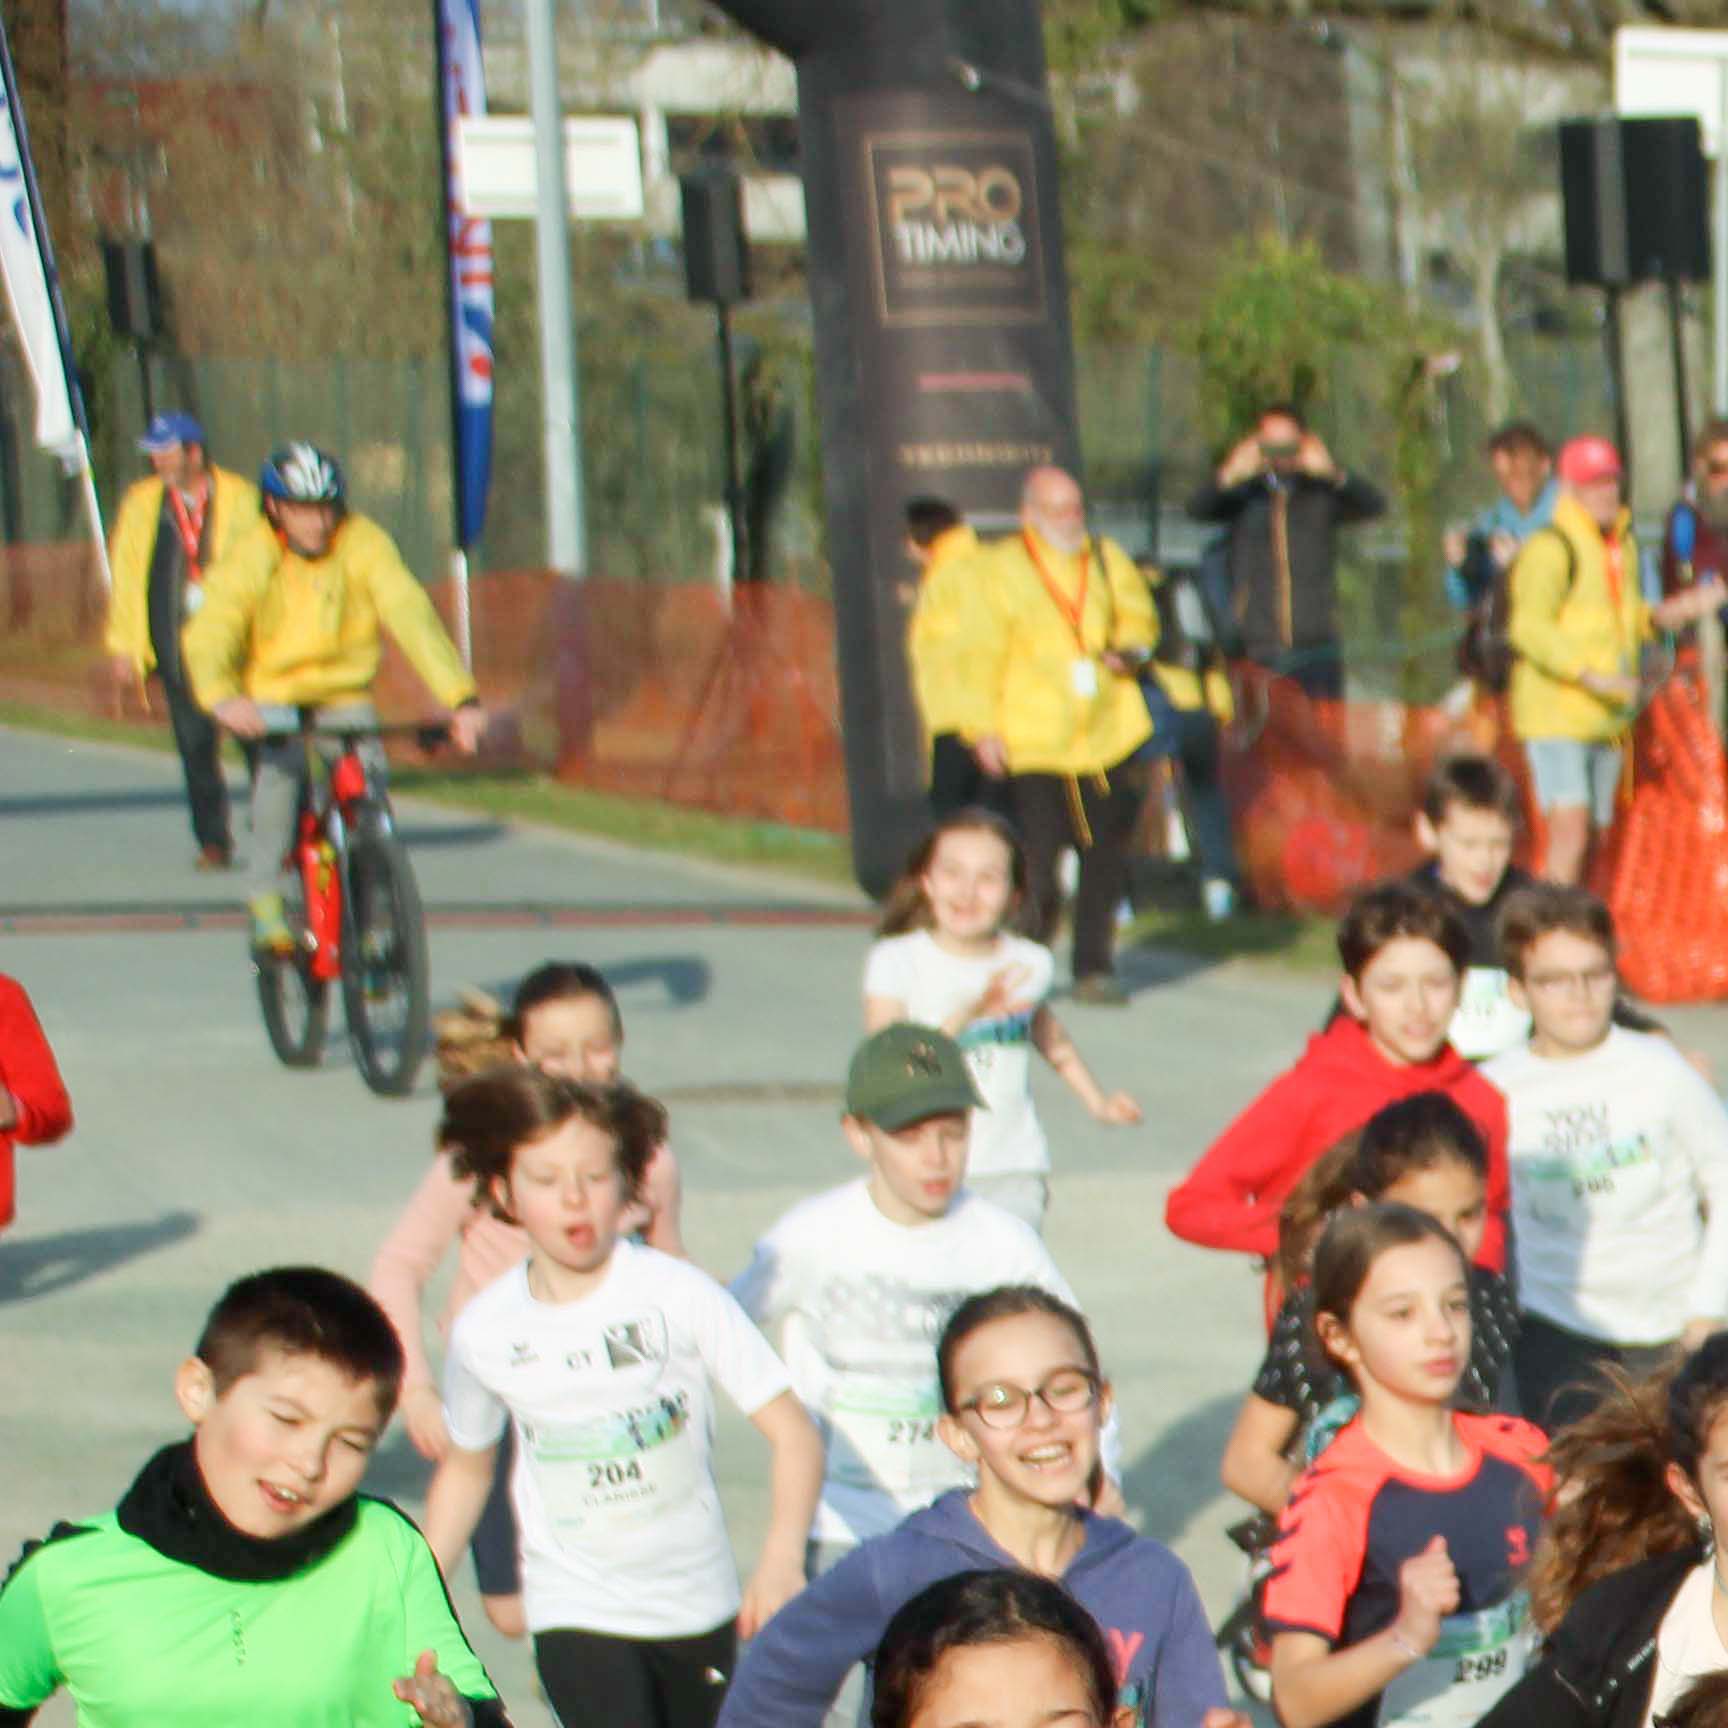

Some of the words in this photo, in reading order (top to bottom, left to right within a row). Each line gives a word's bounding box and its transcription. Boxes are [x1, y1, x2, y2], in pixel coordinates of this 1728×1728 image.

[887, 165, 1021, 227] PRO
[895, 221, 1026, 264] TIMING
[587, 1461, 642, 1488] 204
